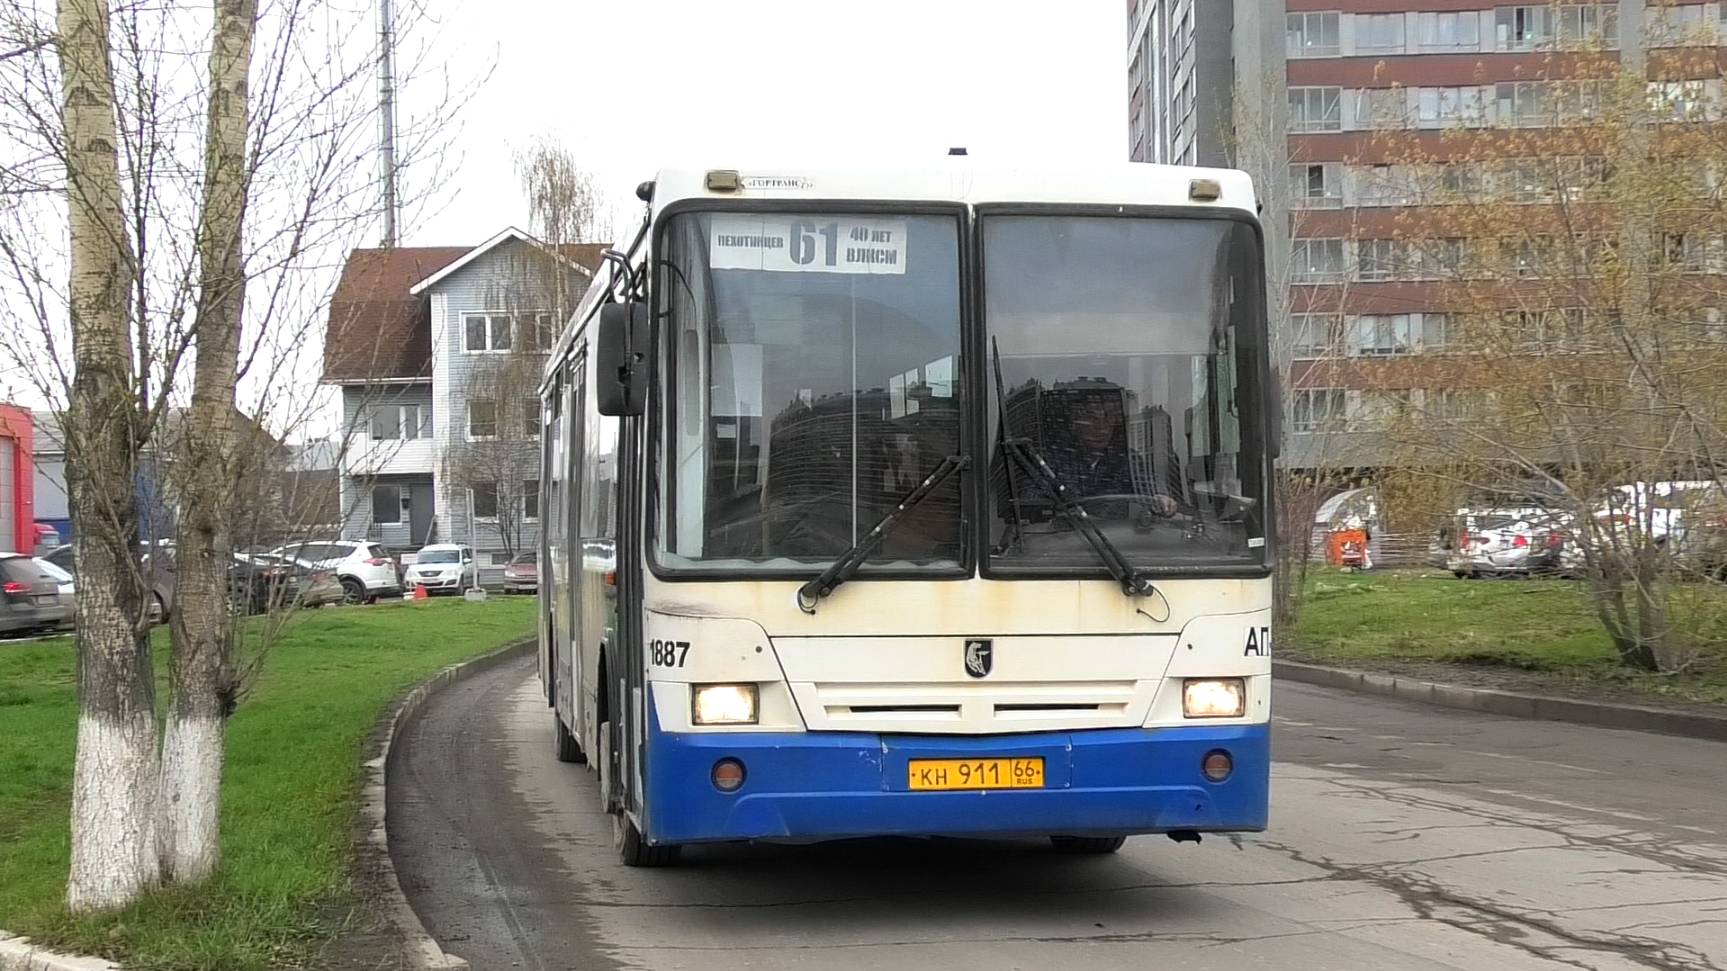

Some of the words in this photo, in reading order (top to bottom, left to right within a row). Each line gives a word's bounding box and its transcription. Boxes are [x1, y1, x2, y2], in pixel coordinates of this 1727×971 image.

[718, 234, 784, 250] ПЕХОТИНЦЕВ
[789, 220, 838, 267] 61
[850, 227, 869, 241] 40
[871, 230, 893, 243] ЛЕТ
[846, 247, 898, 265] ВЛКСМ
[649, 638, 691, 668] 1887
[958, 762, 1000, 785] 911
[1014, 760, 1035, 777] 66
